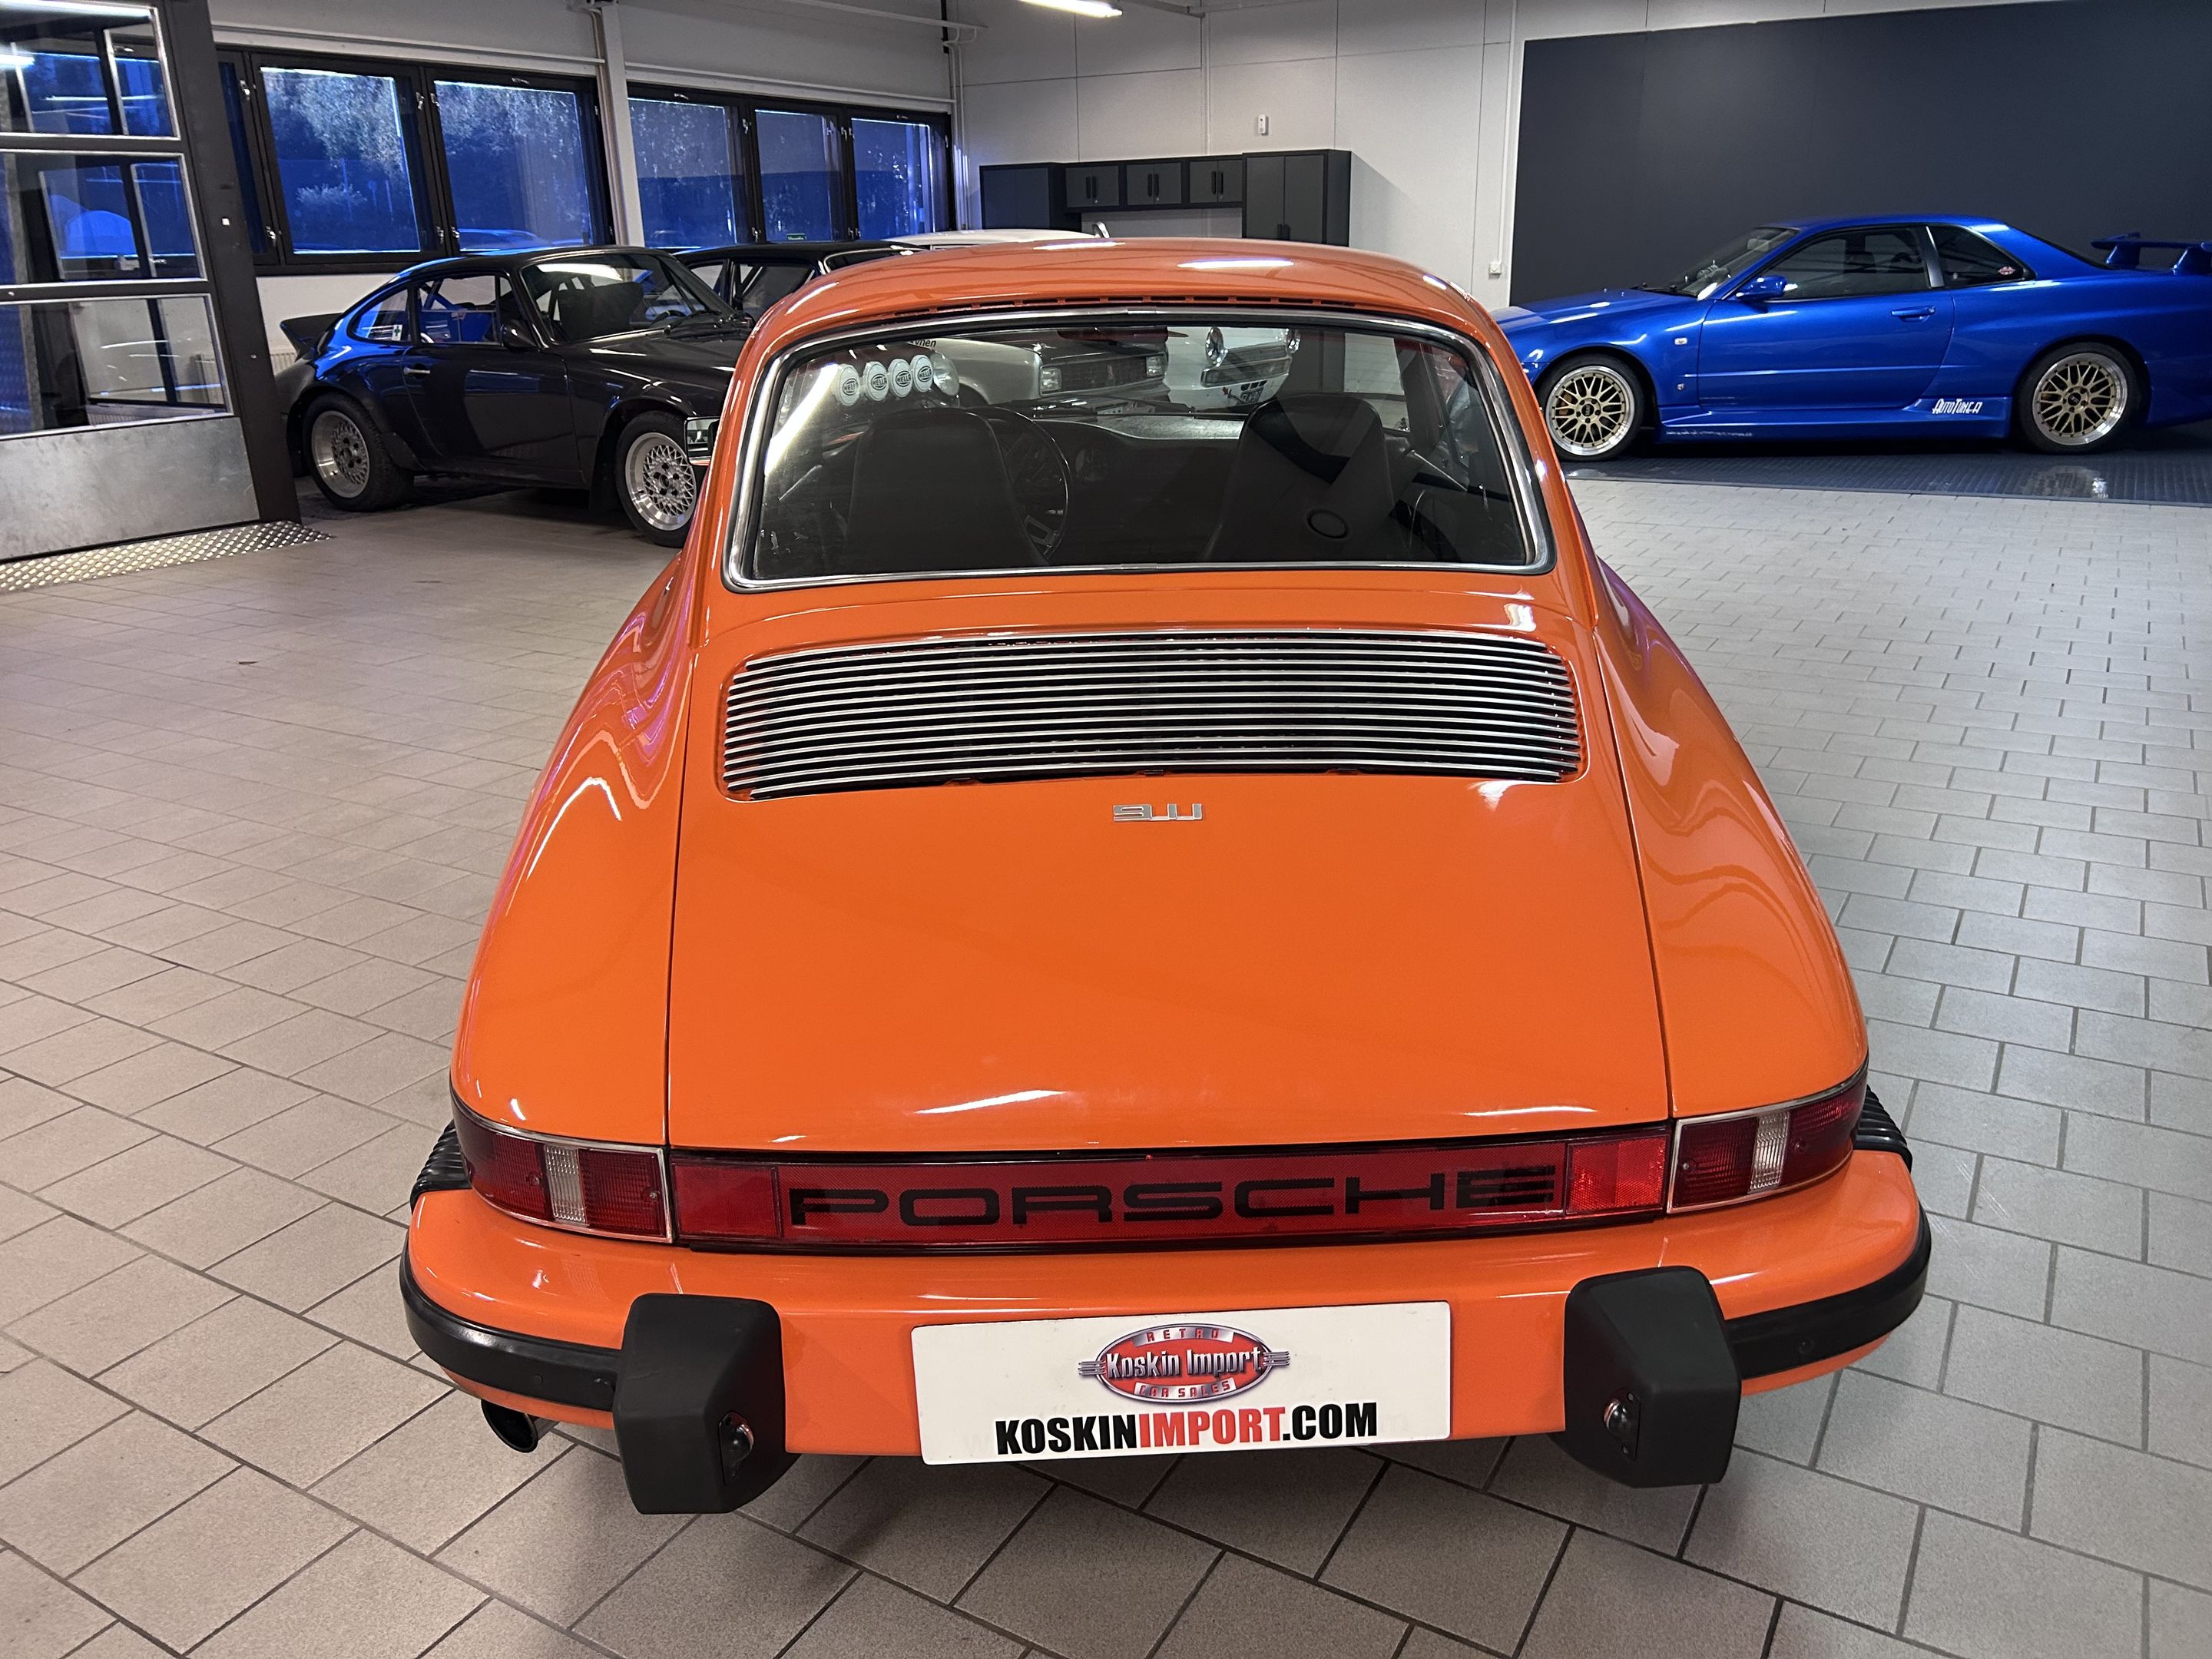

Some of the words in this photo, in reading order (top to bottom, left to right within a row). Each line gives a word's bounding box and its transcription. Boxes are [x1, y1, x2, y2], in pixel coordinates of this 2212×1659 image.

[872, 377, 887, 386] HELLA
[896, 374, 912, 383] HELLA
[1113, 803, 1203, 821] 911
[789, 1165, 1555, 1226] PORSCHE
[1147, 1328, 1220, 1343] RETRO
[1106, 1350, 1181, 1379] Koskin
[1186, 1346, 1262, 1378] Import
[1139, 1385, 1169, 1398] CAR
[1178, 1381, 1230, 1398] SALES
[995, 1402, 1377, 1455] KOSKINIMPORT.COM
